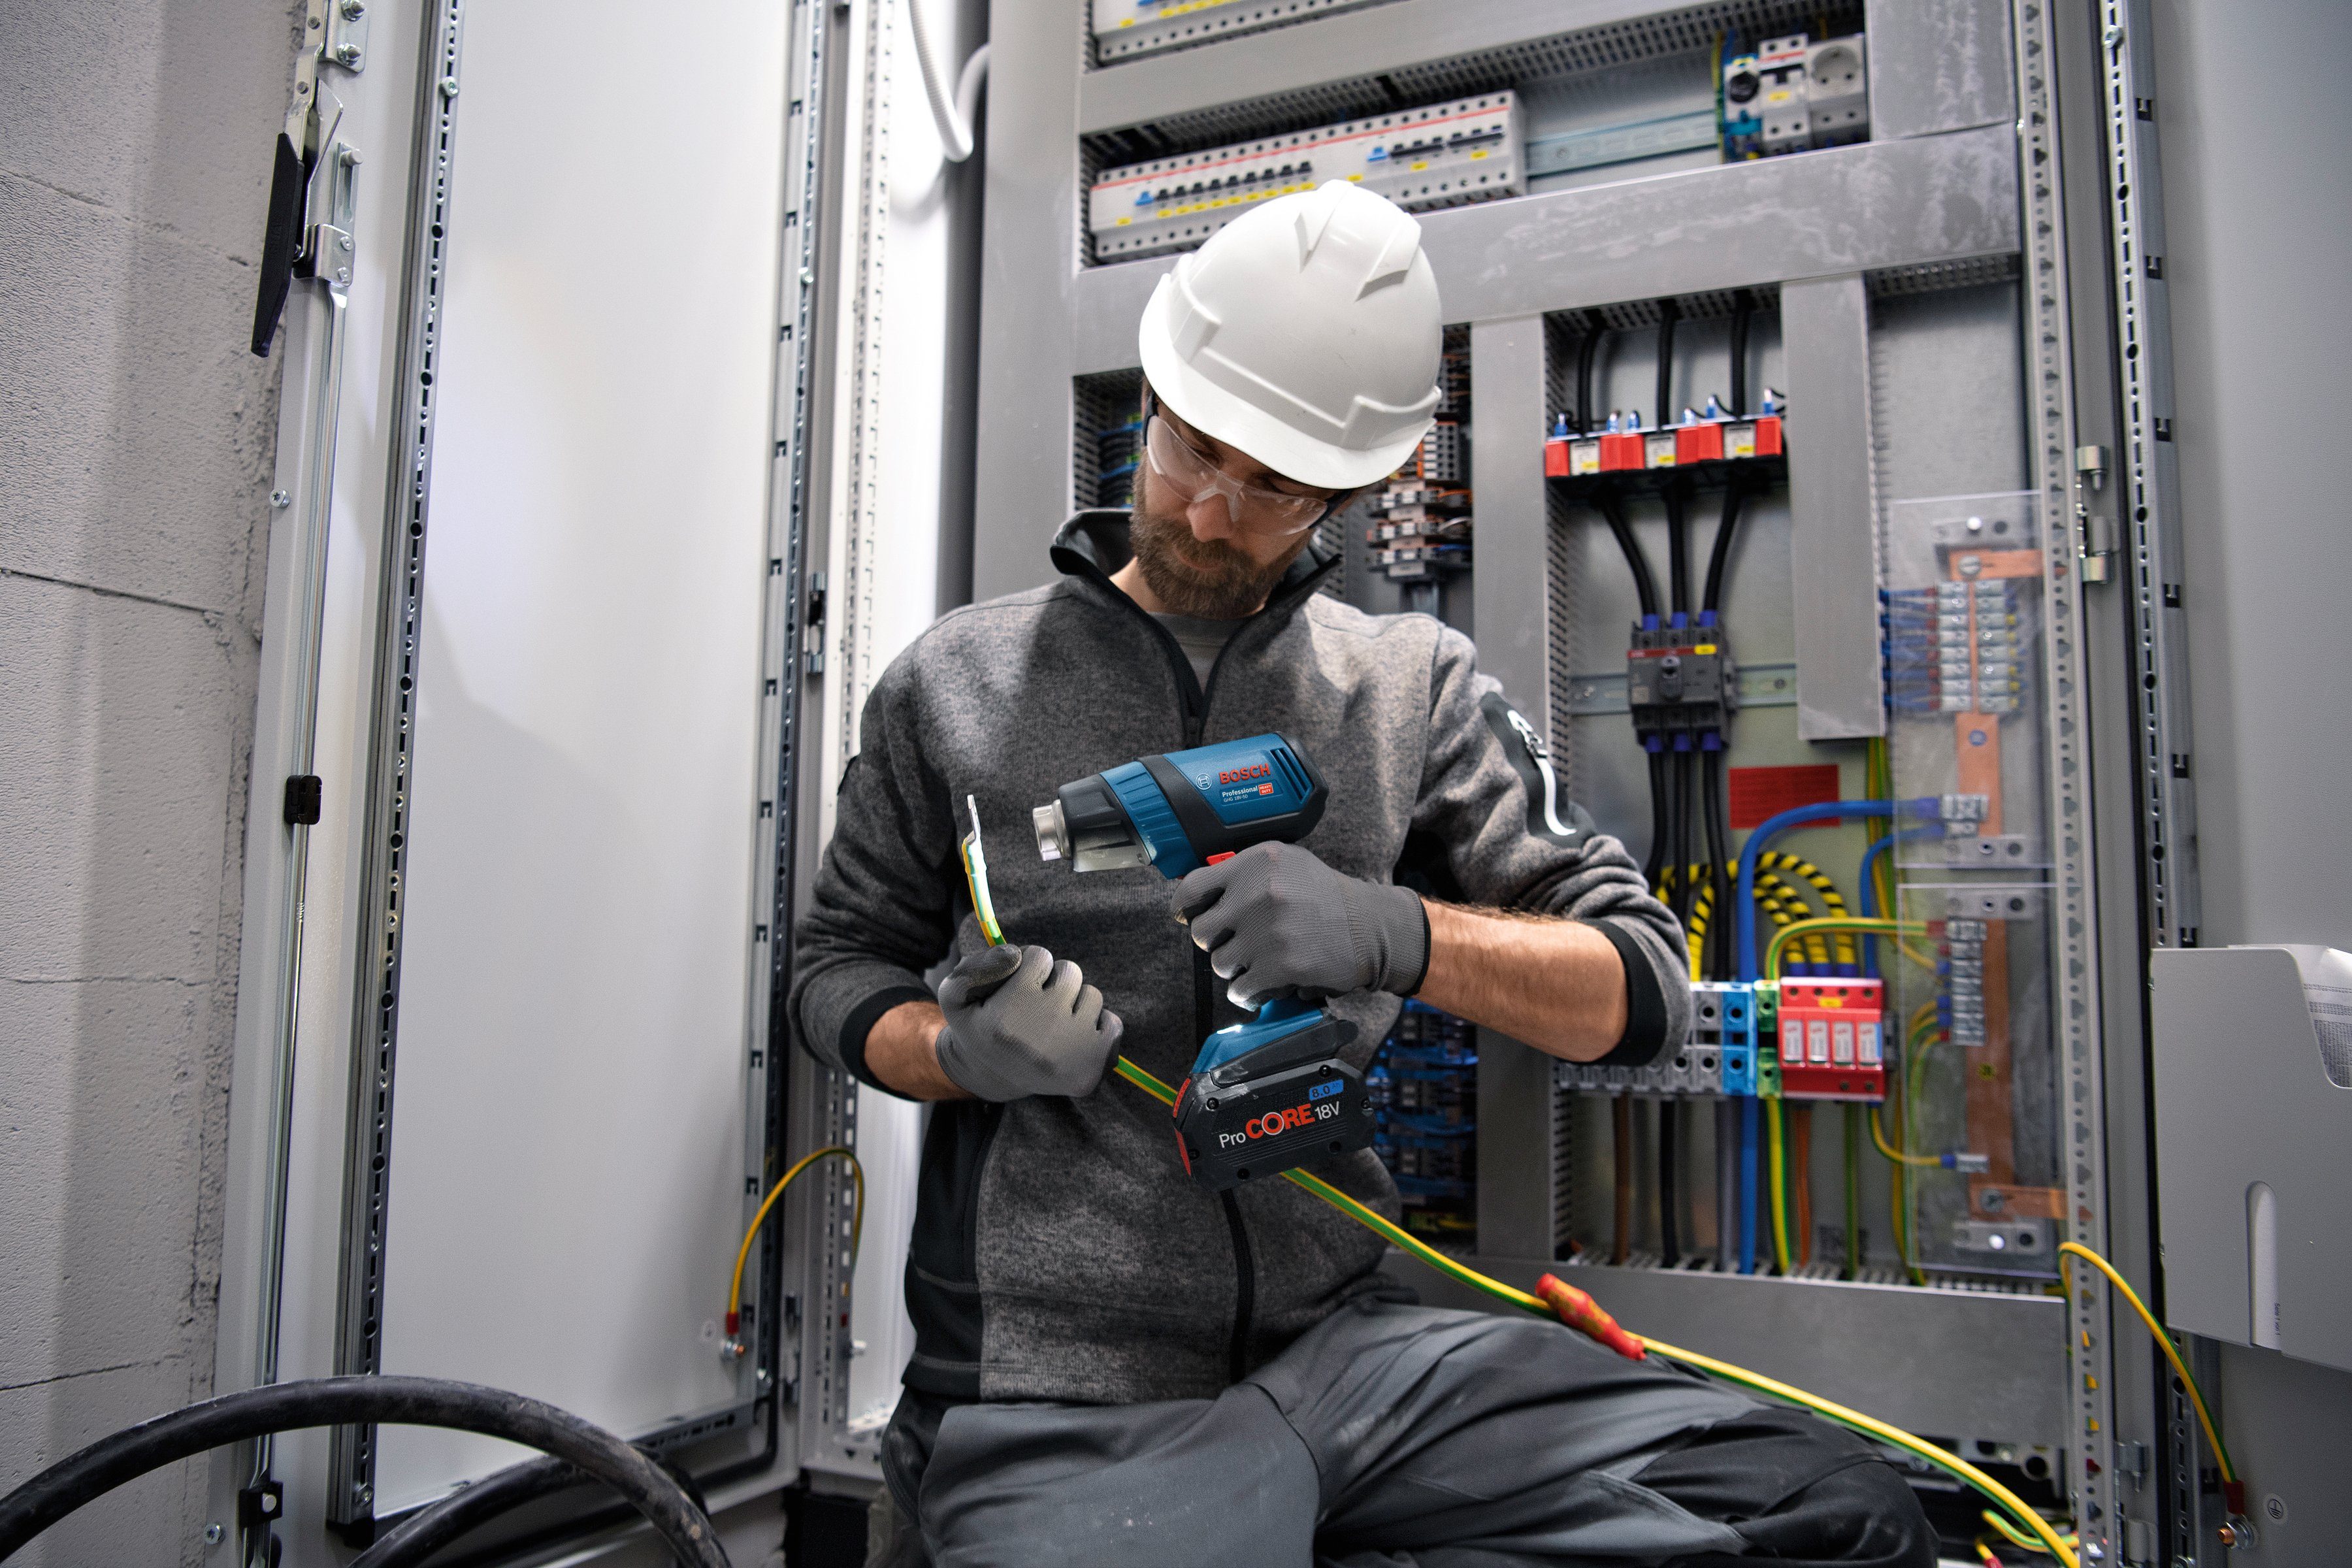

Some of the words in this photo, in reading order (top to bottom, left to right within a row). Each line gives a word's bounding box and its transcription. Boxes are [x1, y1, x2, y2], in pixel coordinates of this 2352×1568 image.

[1219, 763, 1271, 784] BOSCH
[1222, 785, 1258, 797] Professional
[1312, 1085, 1330, 1098] 8.0
[1315, 1101, 1340, 1120] 18V
